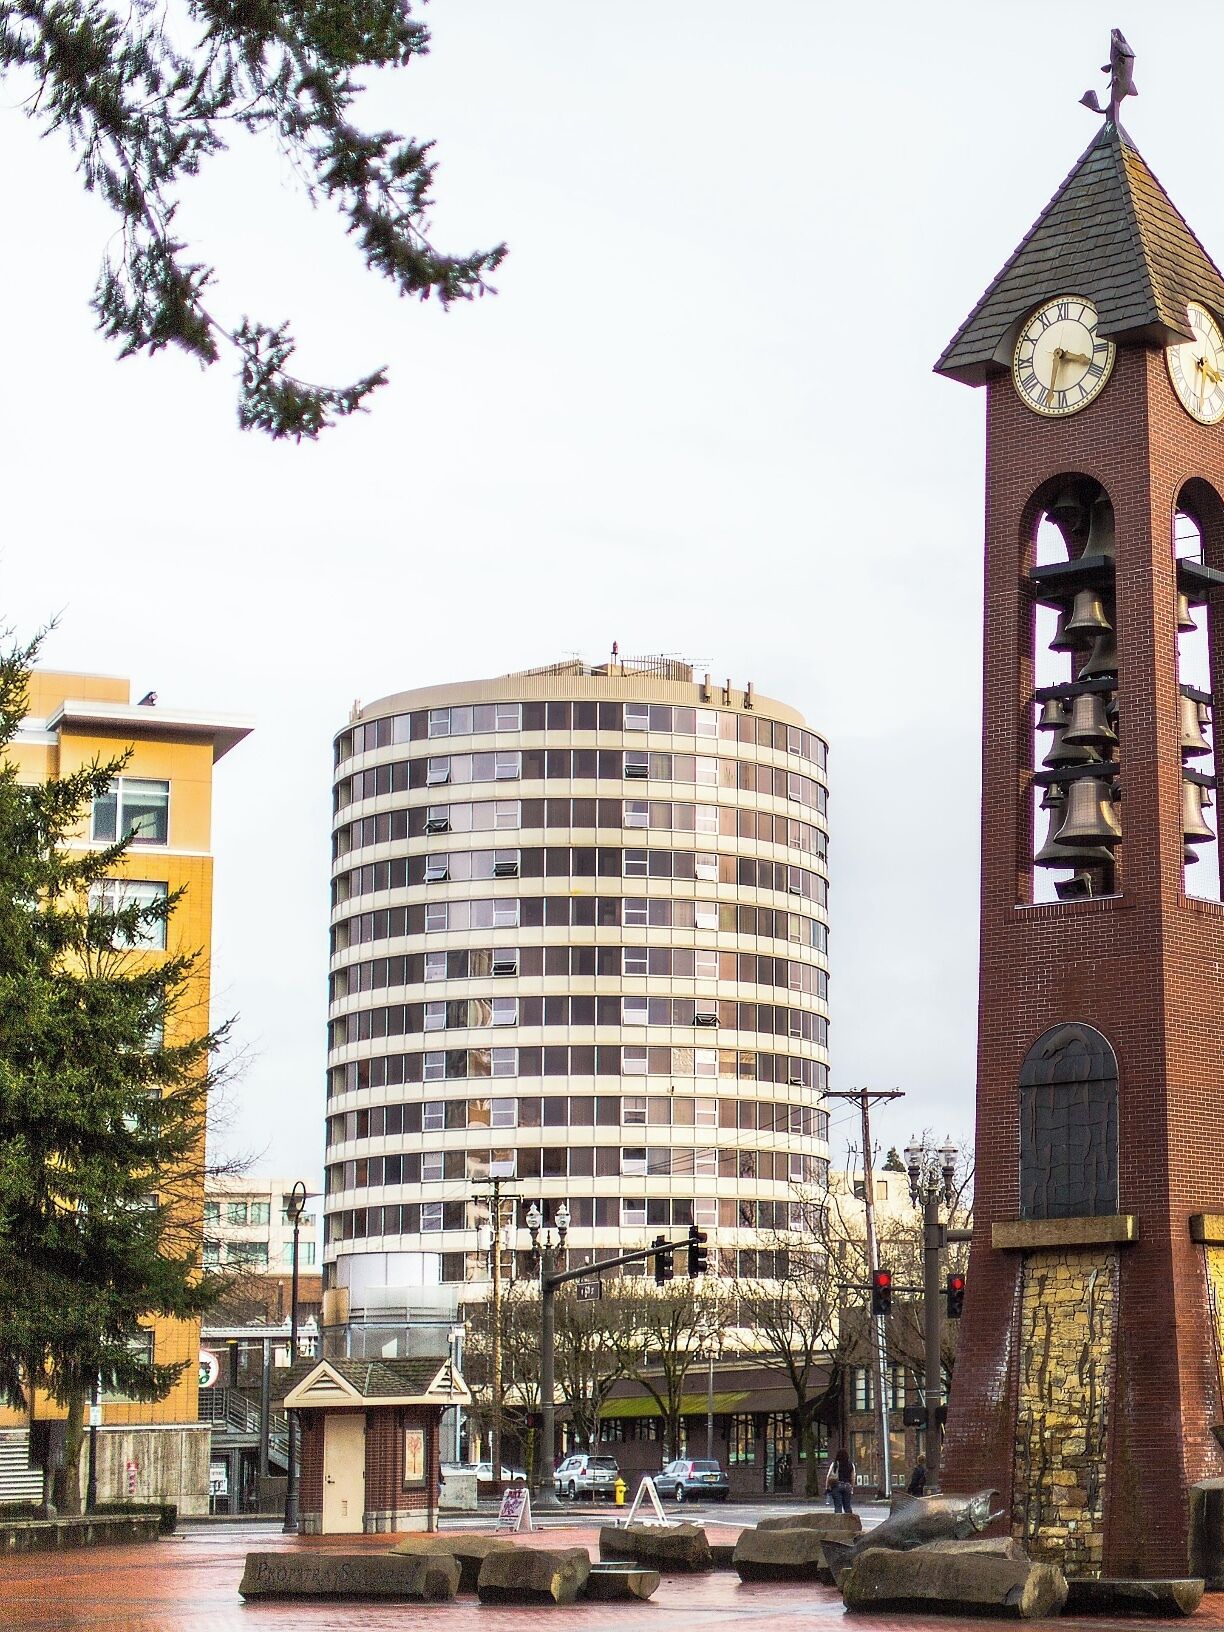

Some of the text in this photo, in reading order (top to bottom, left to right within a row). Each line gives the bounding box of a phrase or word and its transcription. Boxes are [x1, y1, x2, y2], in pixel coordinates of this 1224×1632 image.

[1057, 302, 1069, 320] XII
[1037, 311, 1052, 331] XI
[1022, 333, 1039, 346] X
[1093, 342, 1108, 353] III
[1018, 356, 1034, 370] IX
[1021, 372, 1039, 395] VIII
[1078, 383, 1089, 398] V
[1058, 391, 1068, 408] VI
